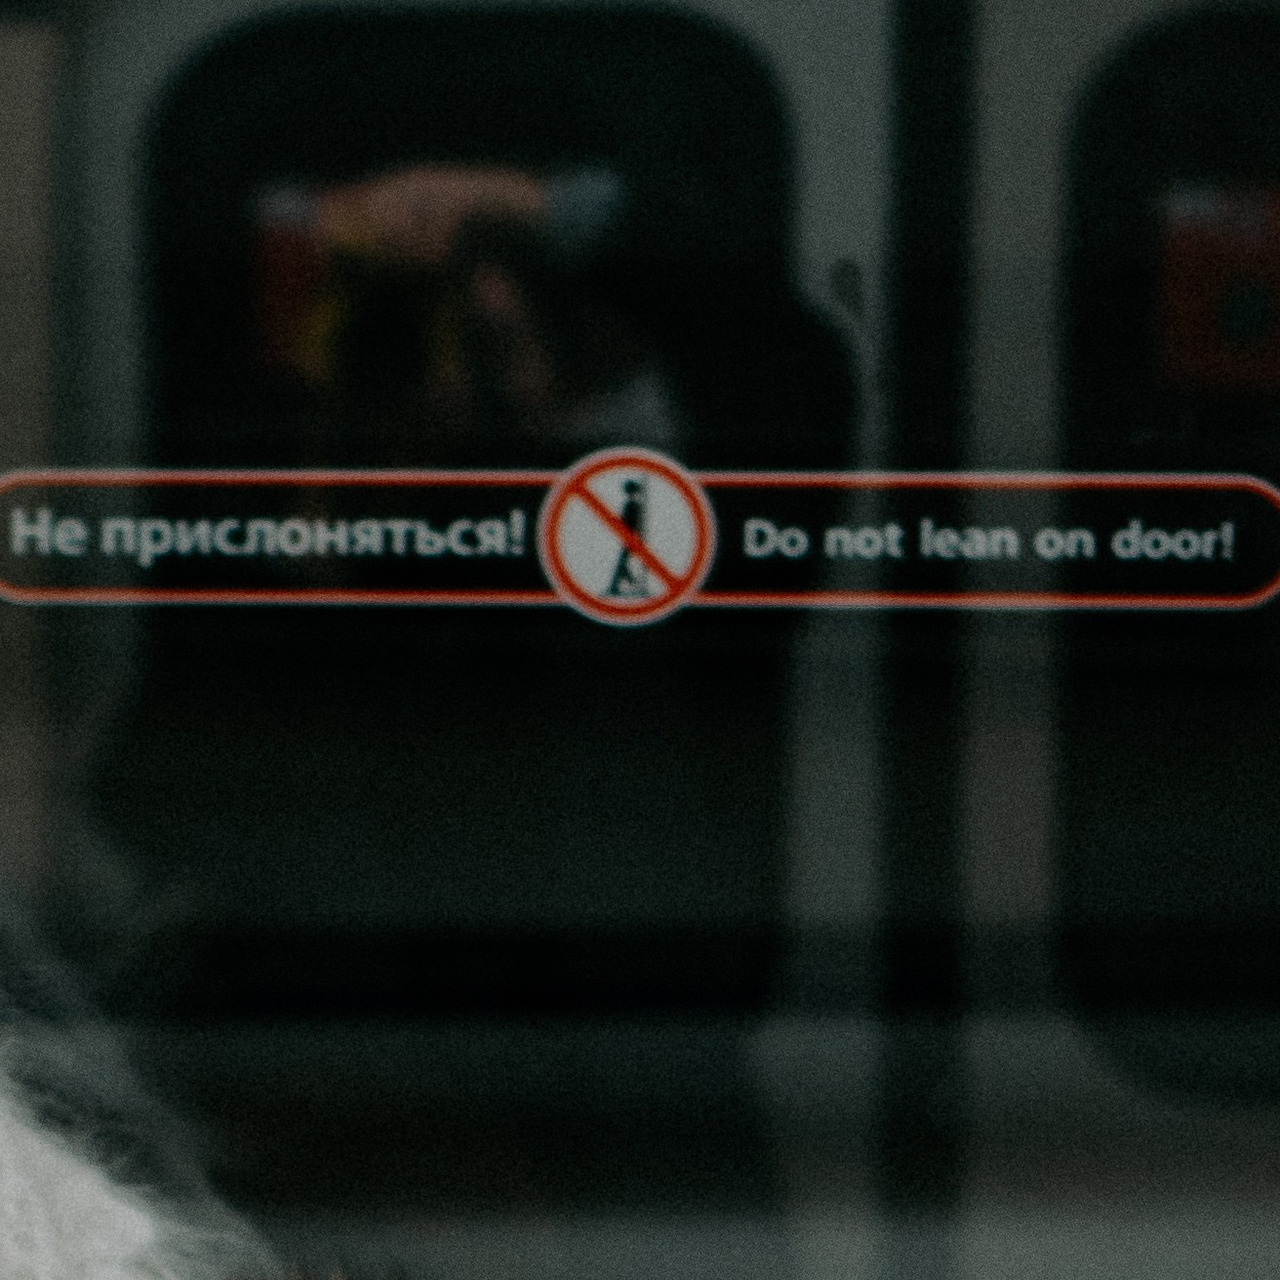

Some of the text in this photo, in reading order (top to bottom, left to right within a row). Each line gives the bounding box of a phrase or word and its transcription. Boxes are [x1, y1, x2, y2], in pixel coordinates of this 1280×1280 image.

[9, 507, 526, 568] Не прислоняться!
[742, 517, 1236, 561] Do not lean on door!
